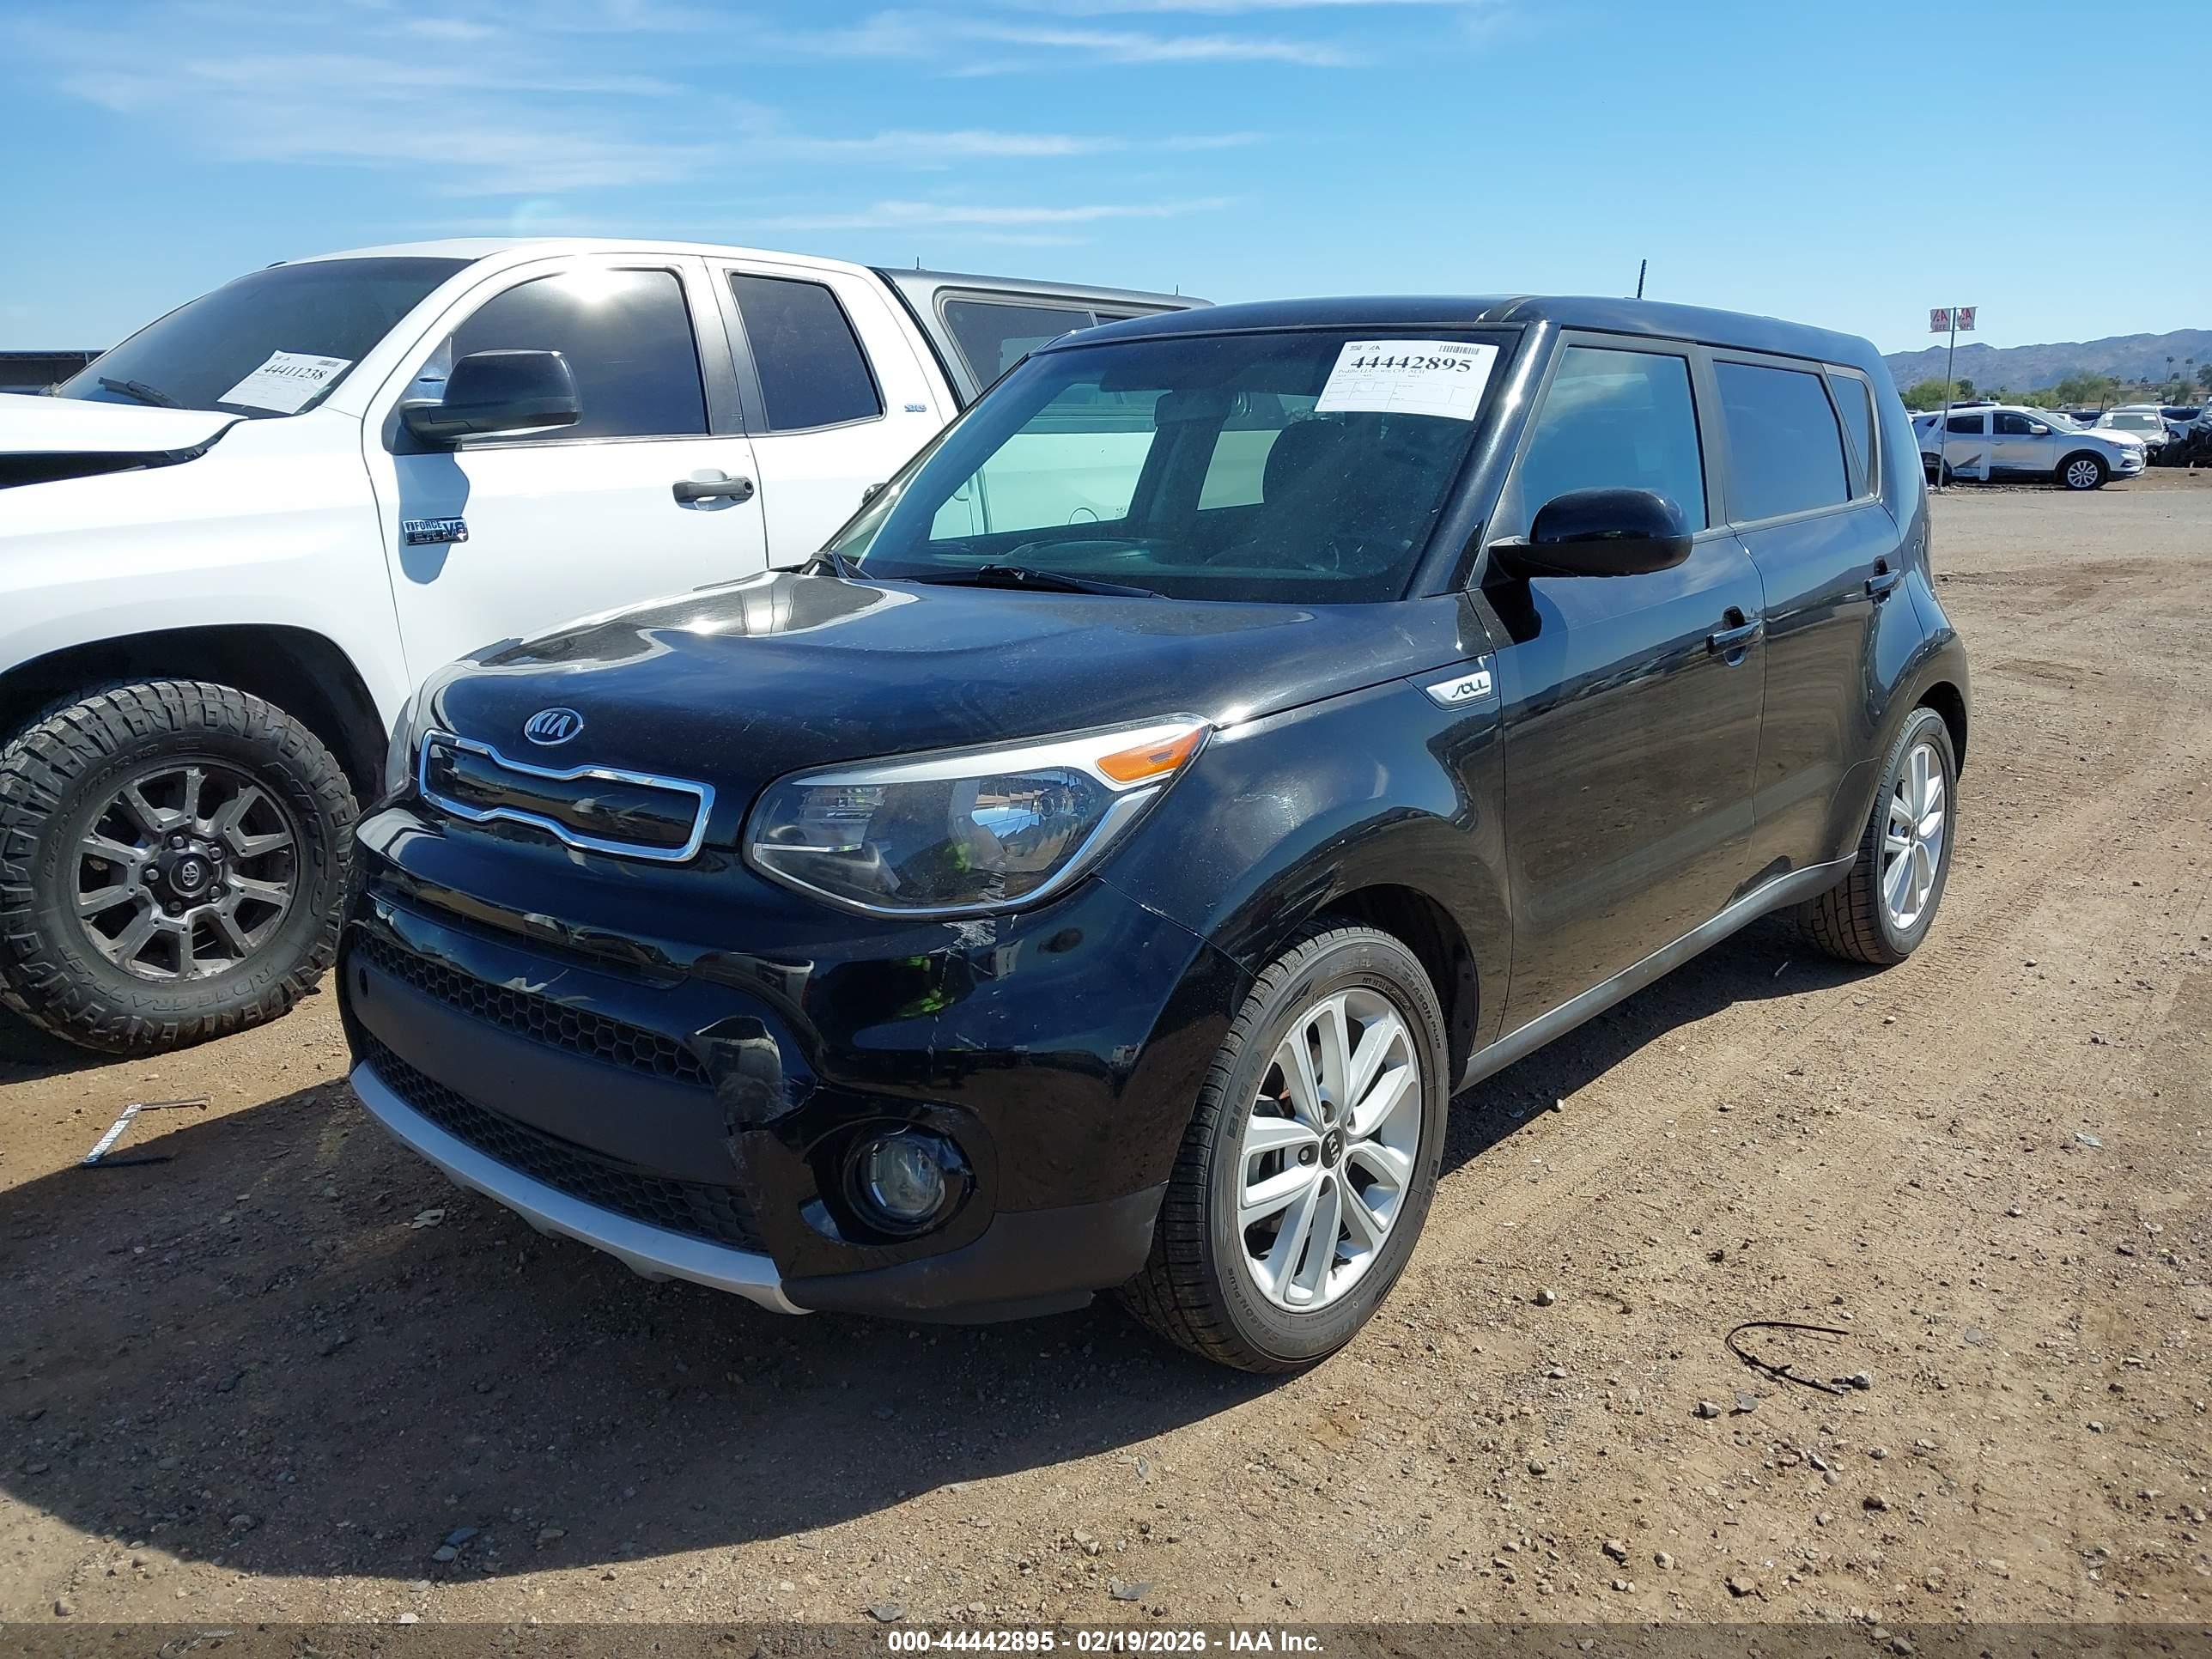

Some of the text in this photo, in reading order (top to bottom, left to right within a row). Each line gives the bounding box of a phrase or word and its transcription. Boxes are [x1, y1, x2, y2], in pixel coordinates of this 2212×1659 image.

[264, 364, 328, 380] 44411238
[1350, 355, 1473, 373] 44442895
[528, 712, 572, 738] KIA
[1327, 1132, 1340, 1166] KIA
